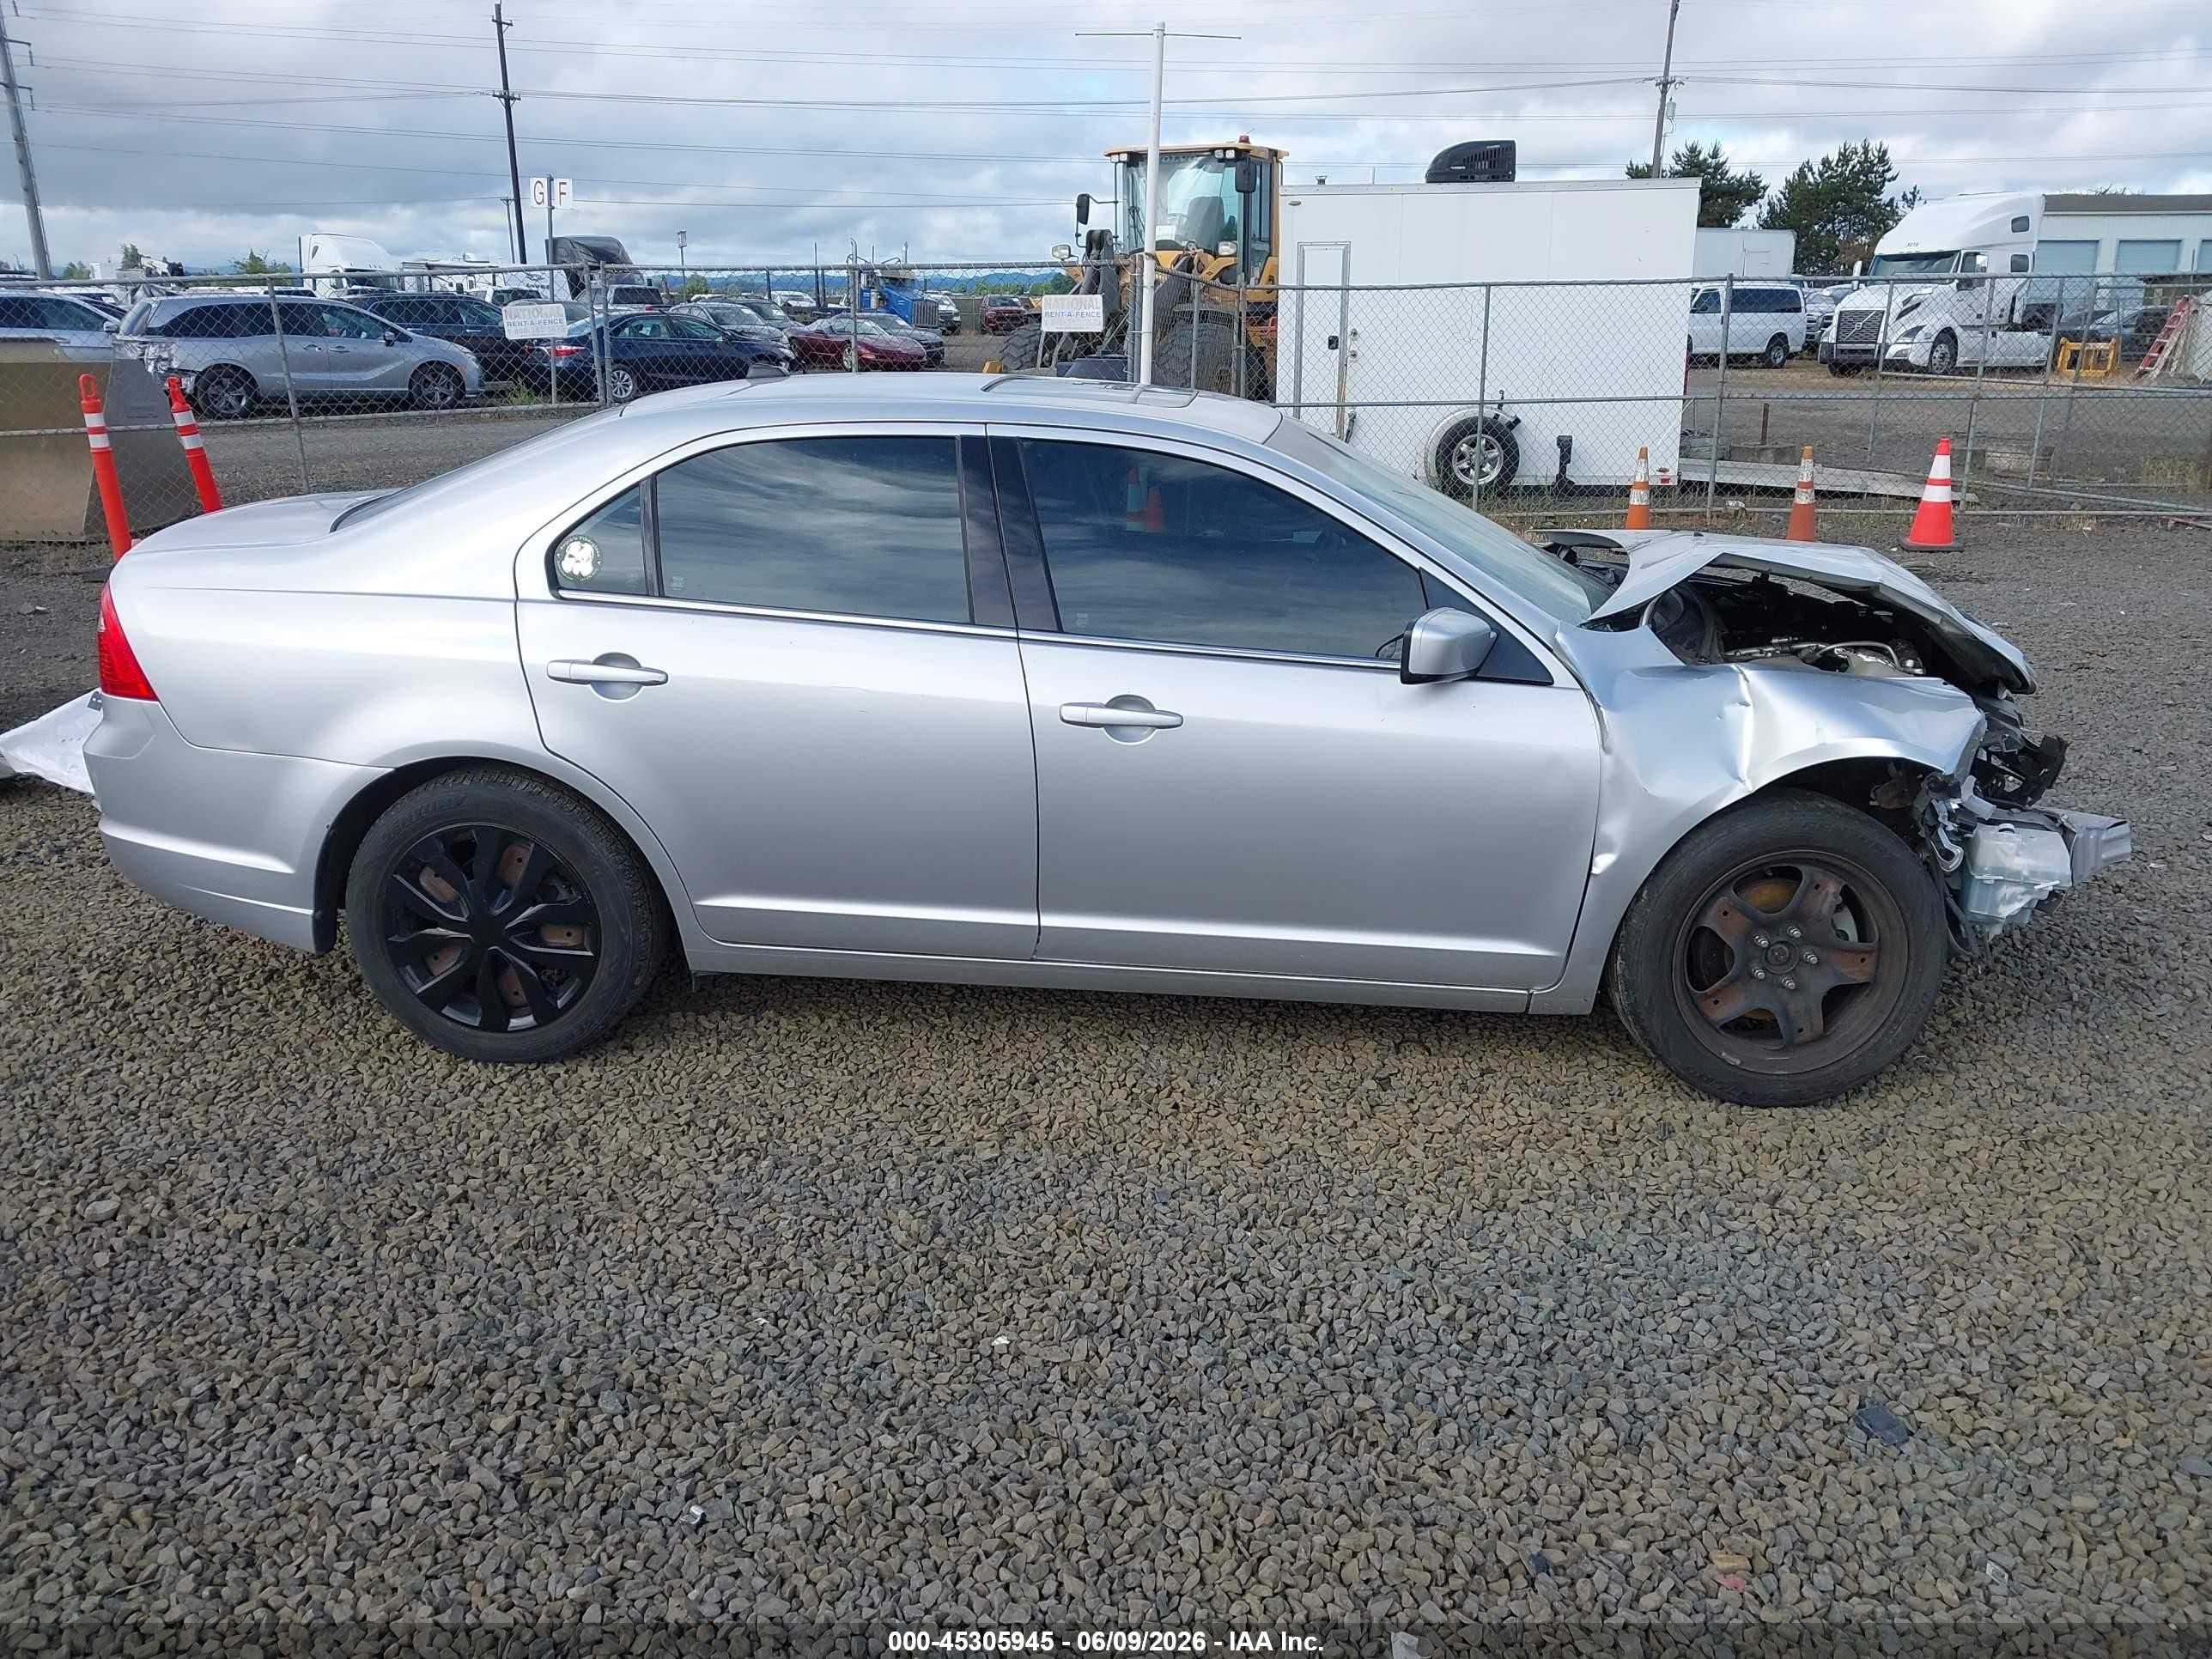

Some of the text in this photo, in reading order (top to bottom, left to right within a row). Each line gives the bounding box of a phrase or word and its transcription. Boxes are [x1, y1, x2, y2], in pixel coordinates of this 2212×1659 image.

[534, 180, 544, 205] G
[559, 182, 567, 206] F
[1044, 297, 1101, 310] NATIONAL
[507, 318, 564, 327] RENT-A-FENCE
